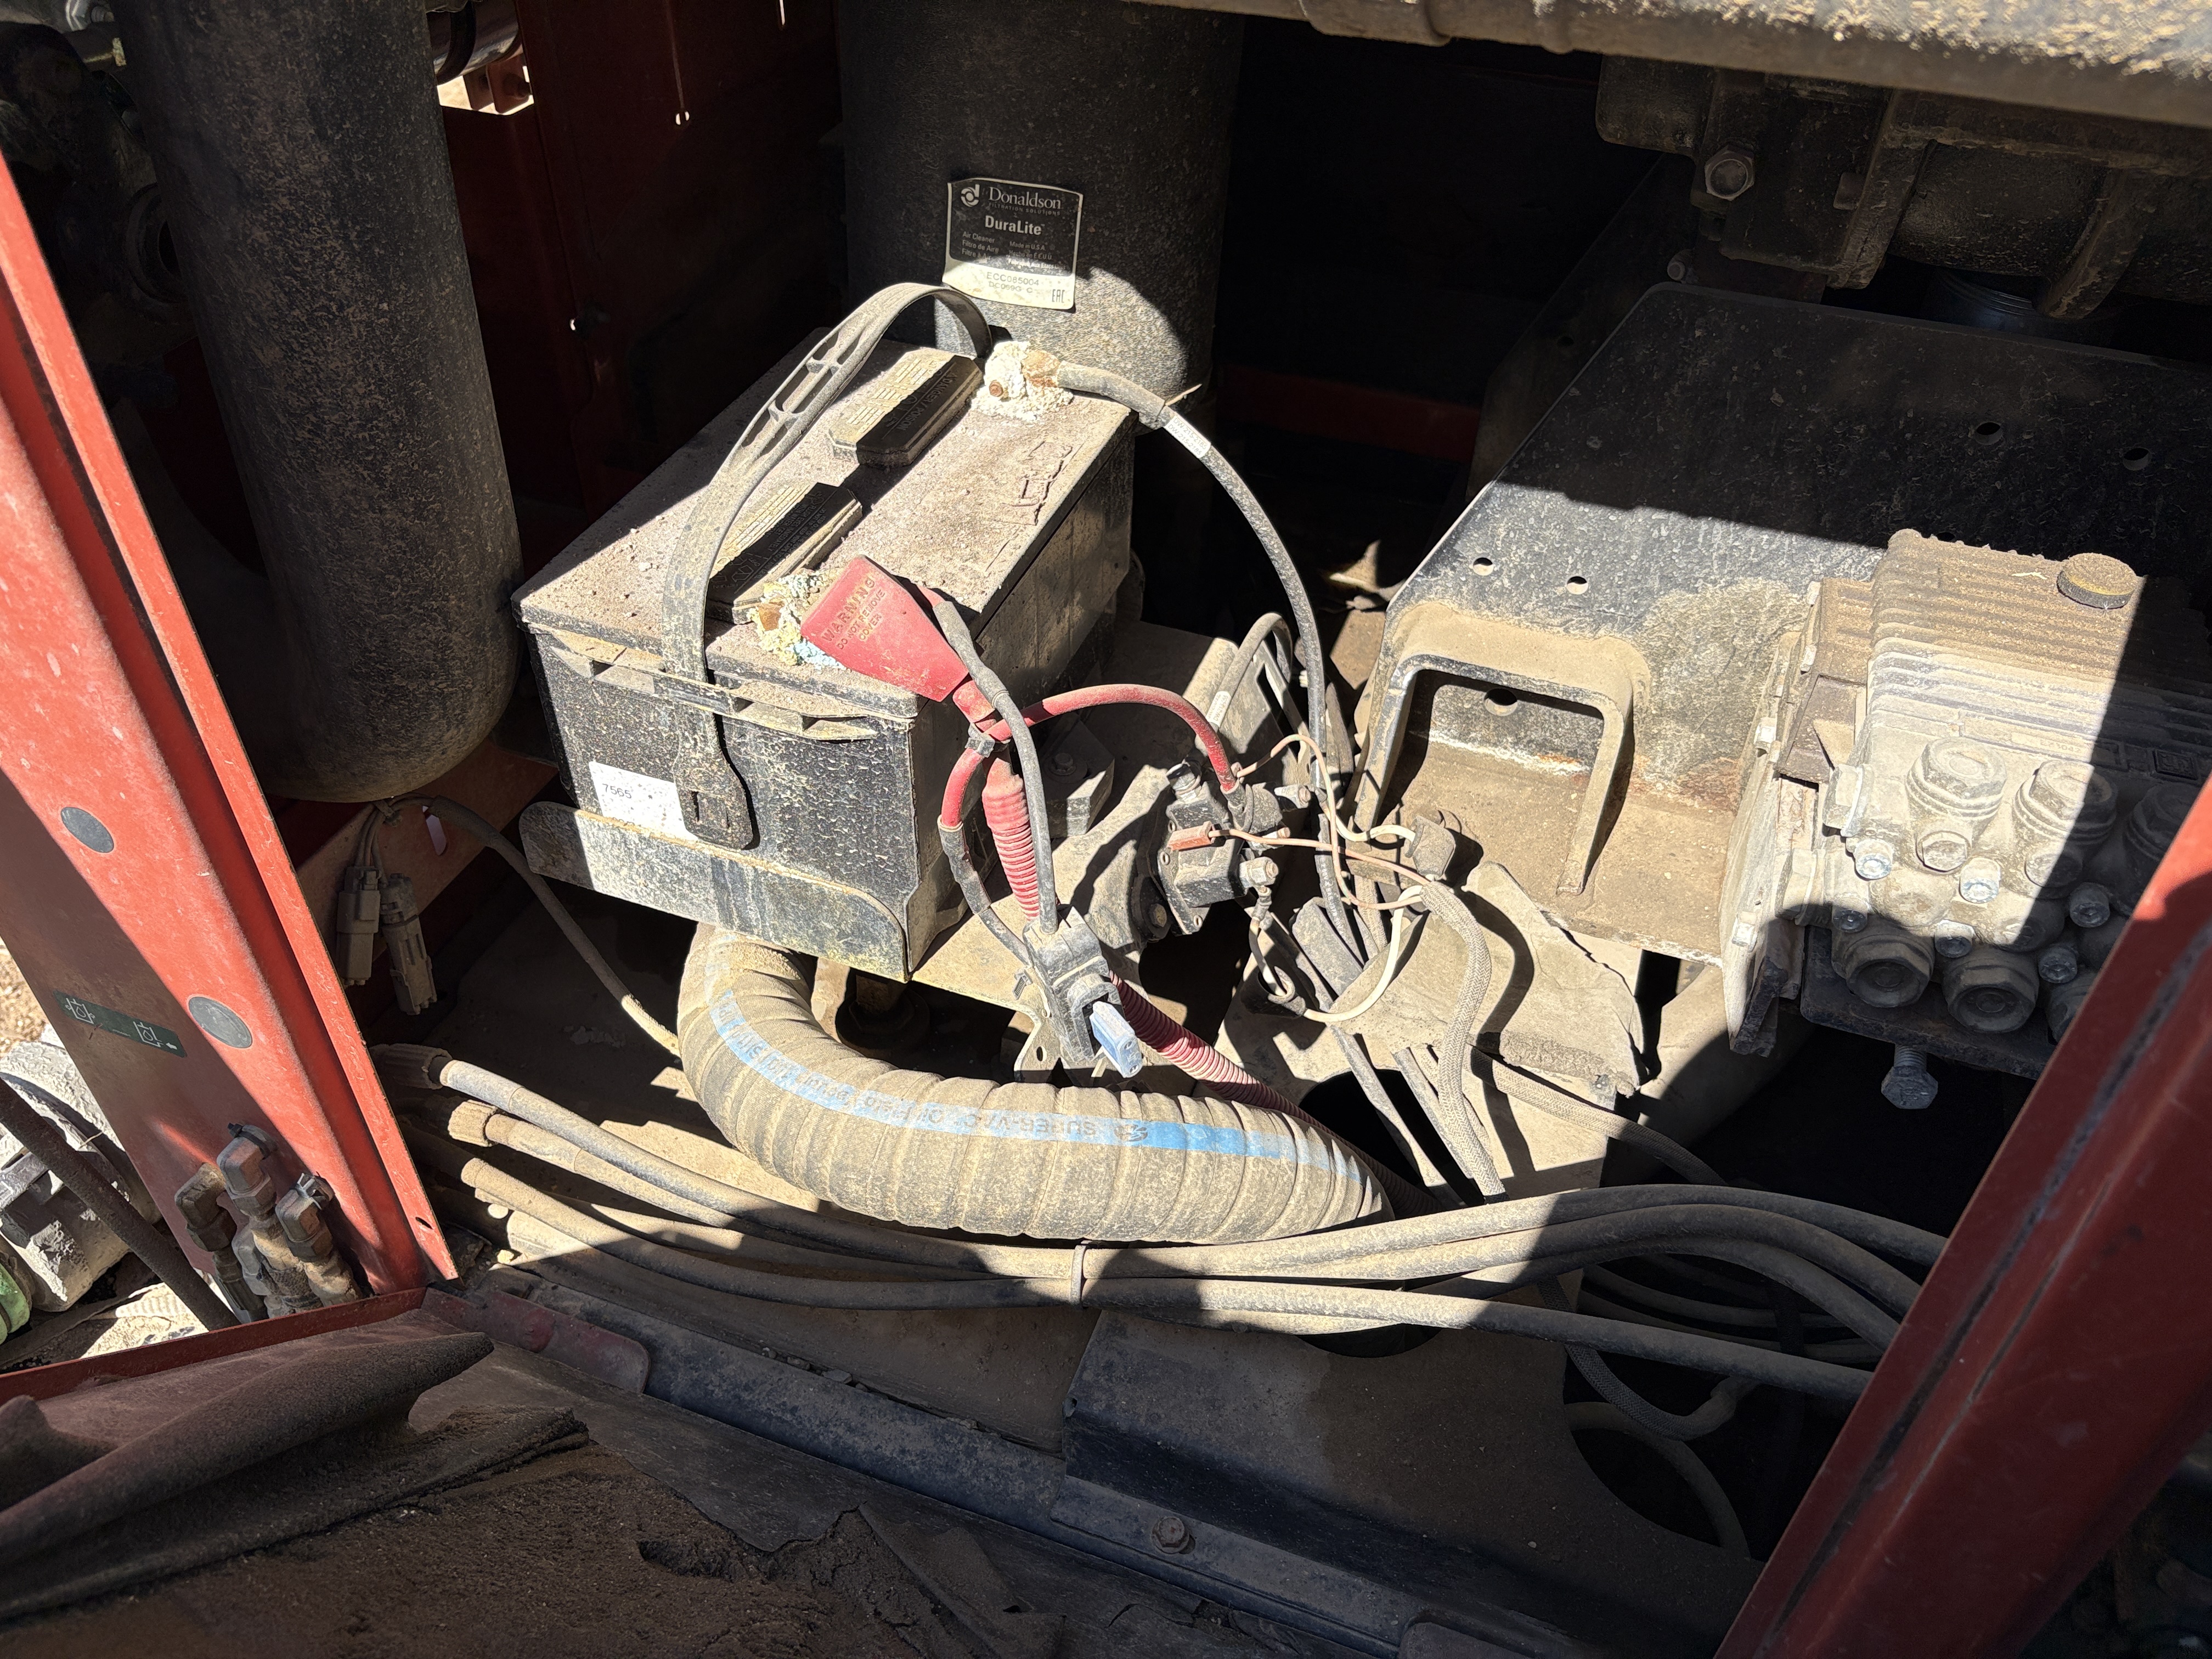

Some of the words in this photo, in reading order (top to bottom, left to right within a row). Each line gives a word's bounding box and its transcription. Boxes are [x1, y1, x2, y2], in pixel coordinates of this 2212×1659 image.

[989, 187, 1062, 210] Donaldson
[962, 240, 977, 249] Filtro
[986, 244, 999, 253] Aire
[972, 233, 995, 244] Cleaner
[962, 249, 976, 258] Filtre
[986, 272, 1039, 286] ECC085004
[927, 377, 953, 403] DANGER
[898, 406, 924, 431] POISON
[1167, 424, 1202, 455] DW-215-2185
[1173, 417, 1207, 450] DW-215-2185
[822, 577, 875, 642] WARNING
[836, 637, 848, 650] DO
[847, 620, 861, 639] NOT
[858, 589, 886, 621] REMOVE
[859, 612, 883, 641] COVER
[602, 783, 632, 799] 7565
